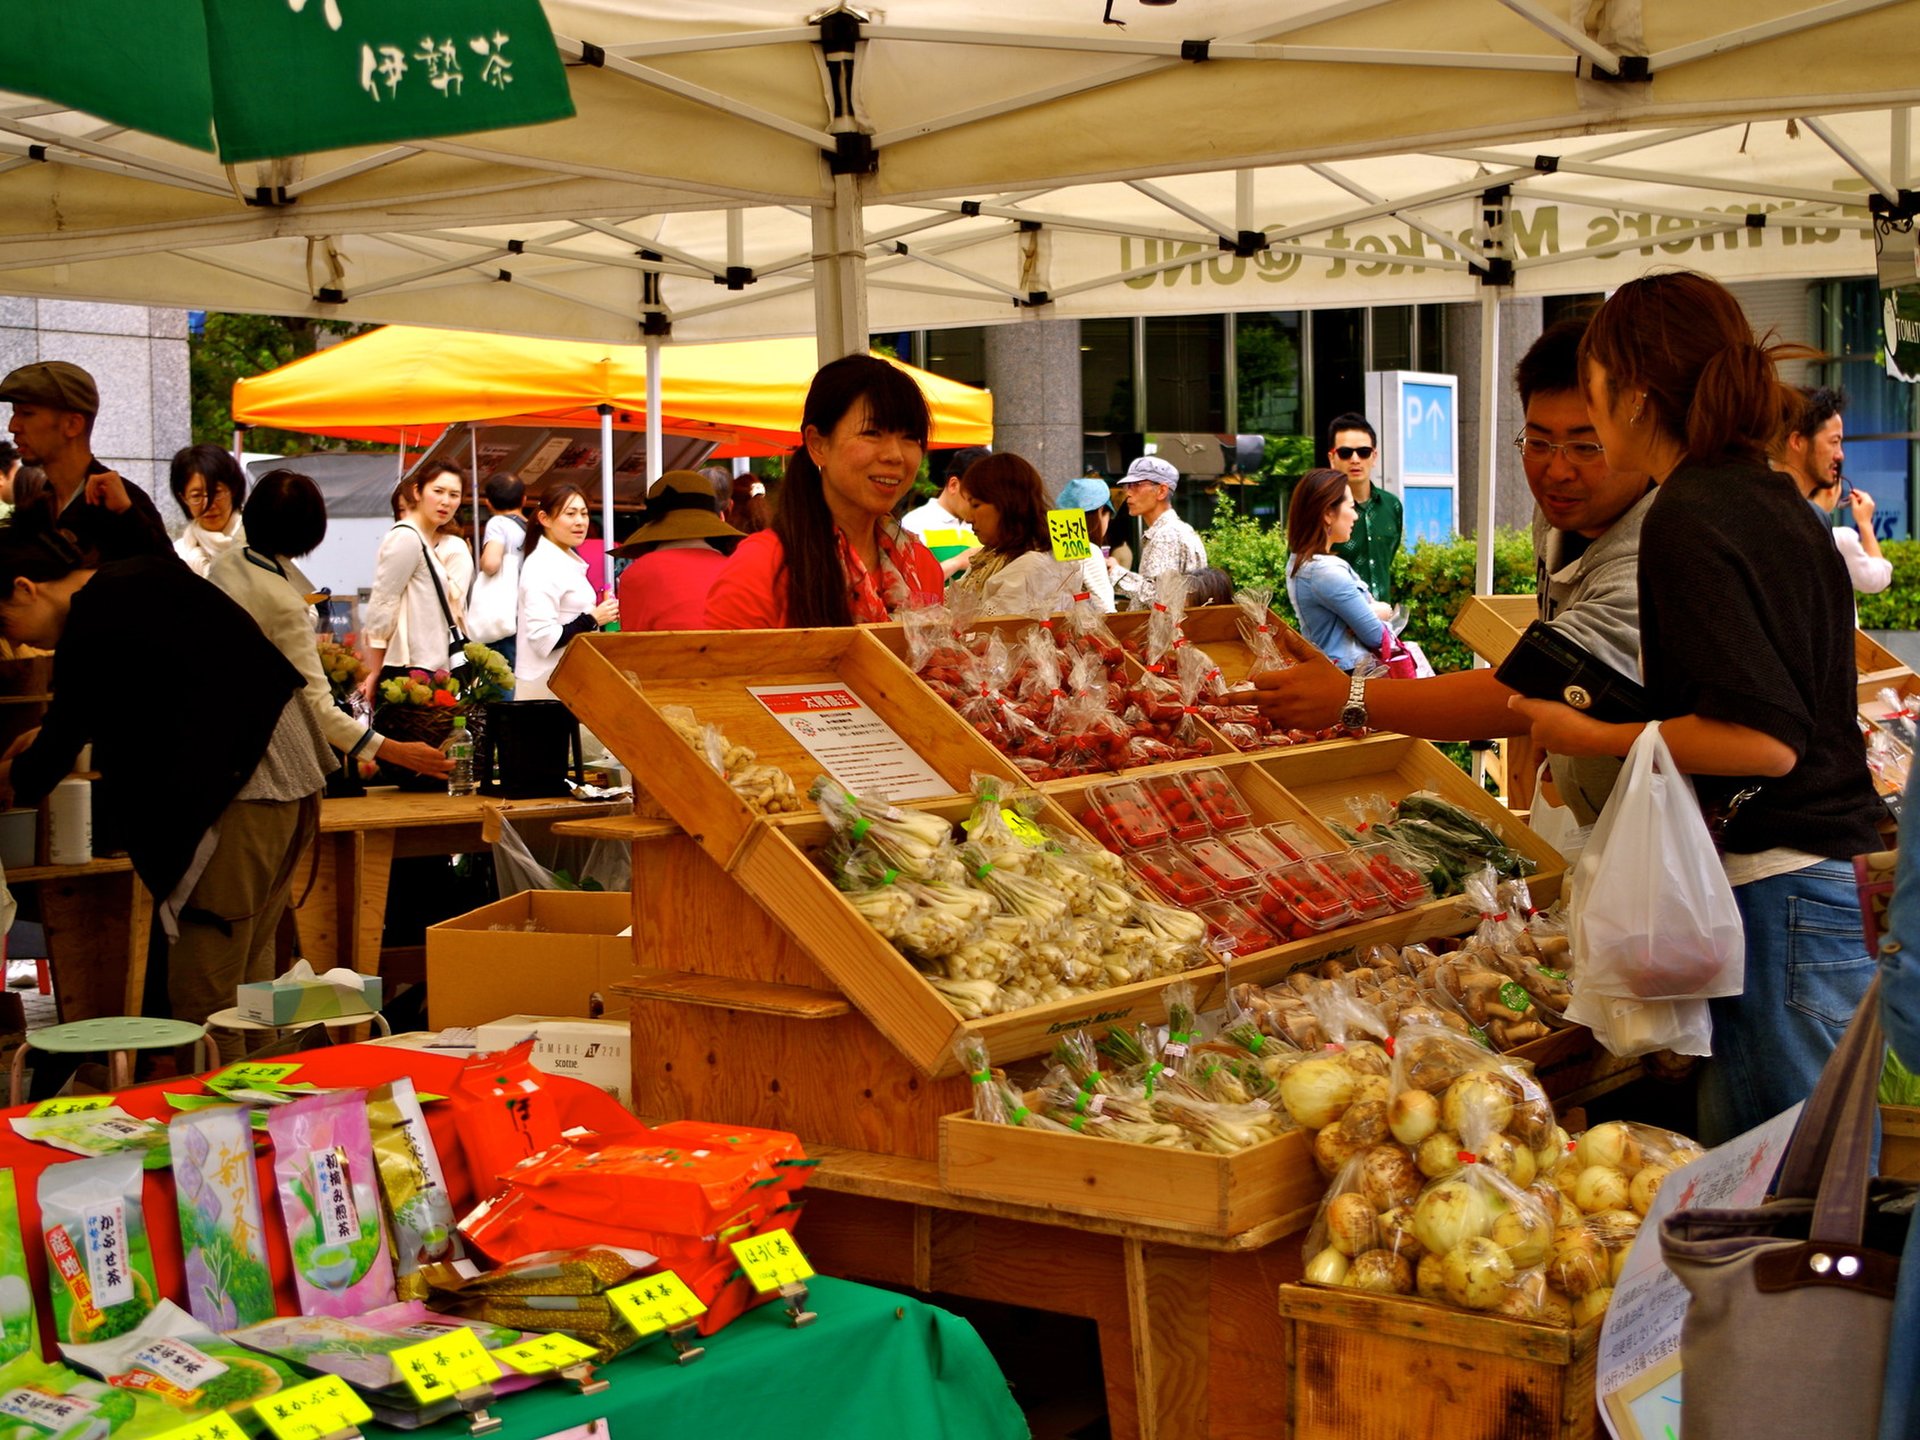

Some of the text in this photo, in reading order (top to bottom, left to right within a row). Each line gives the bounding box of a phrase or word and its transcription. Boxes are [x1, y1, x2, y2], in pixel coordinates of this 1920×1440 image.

[361, 31, 513, 102] 伊勢茶
[1895, 318, 1920, 344] TOMAT
[1406, 395, 1423, 440] P
[1050, 517, 1087, 543] ミニトマト
[555, 1059, 578, 1069] scottie
[602, 1046, 621, 1057] 220
[506, 1097, 535, 1158] ほう
[325, 1153, 351, 1238] 初摘み煎茶
[100, 1215, 122, 1288] かぶせ茶
[745, 1239, 791, 1265] ほうじ茶
[50, 1232, 101, 1322] 産地直送
[629, 1283, 673, 1306] 玄米茶
